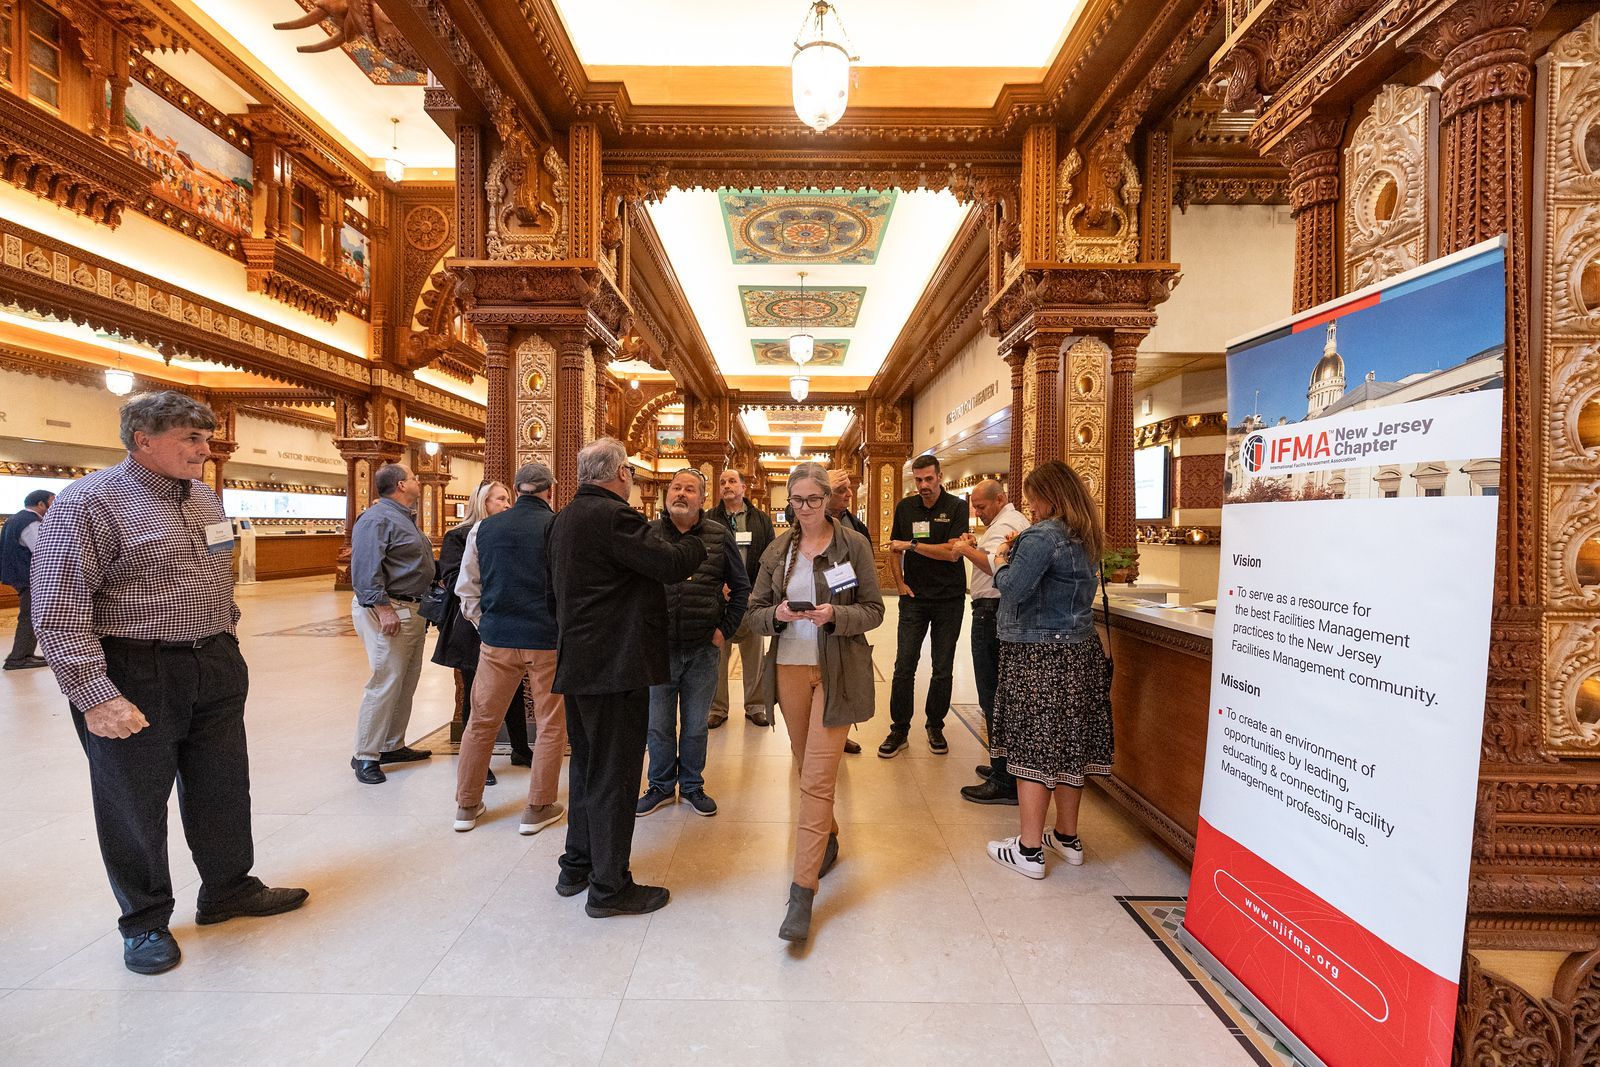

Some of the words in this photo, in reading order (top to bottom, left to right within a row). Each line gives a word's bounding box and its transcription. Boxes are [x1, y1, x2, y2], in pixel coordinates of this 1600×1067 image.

[1334, 426, 1368, 441] New
[1372, 417, 1434, 436] Jersey
[1334, 438, 1397, 457] Chapter
[278, 451, 303, 461] VISITOR
[1330, 456, 1356, 464] Association
[1232, 554, 1262, 568] Vision
[1237, 586, 1247, 598] To
[1249, 590, 1273, 602] serve
[1276, 594, 1288, 605] as
[1290, 596, 1296, 606] a
[1298, 596, 1348, 614] resource
[1352, 602, 1371, 618] for
[1233, 622, 1274, 640] practices
[1277, 631, 1286, 643] to
[1288, 633, 1304, 648] the
[1307, 638, 1333, 654] New
[1337, 644, 1381, 668] Jersey
[1235, 604, 1248, 616] the
[1250, 608, 1270, 621] best
[1273, 611, 1315, 630] Facilities
[1318, 619, 1410, 648] Management
[1221, 673, 1260, 697] Mission
[1232, 640, 1270, 660] Facilities
[1273, 651, 1345, 680] Management
[1349, 670, 1439, 707] community.
[1224, 726, 1286, 761] opportunities
[1288, 752, 1301, 770] by
[1304, 760, 1350, 792] leading,
[1226, 707, 1236, 720] To
[1239, 712, 1268, 732] create
[1270, 726, 1282, 740] an
[1285, 730, 1358, 771] environment
[1361, 763, 1376, 778] of
[1221, 760, 1284, 801] Management
[1286, 793, 1369, 848] professionals.
[1222, 744, 1268, 774] educating
[1270, 764, 1278, 776] &
[1280, 769, 1343, 812] connecting
[1347, 801, 1394, 838] Facility
[1245, 897, 1340, 979] www.njifma.org
